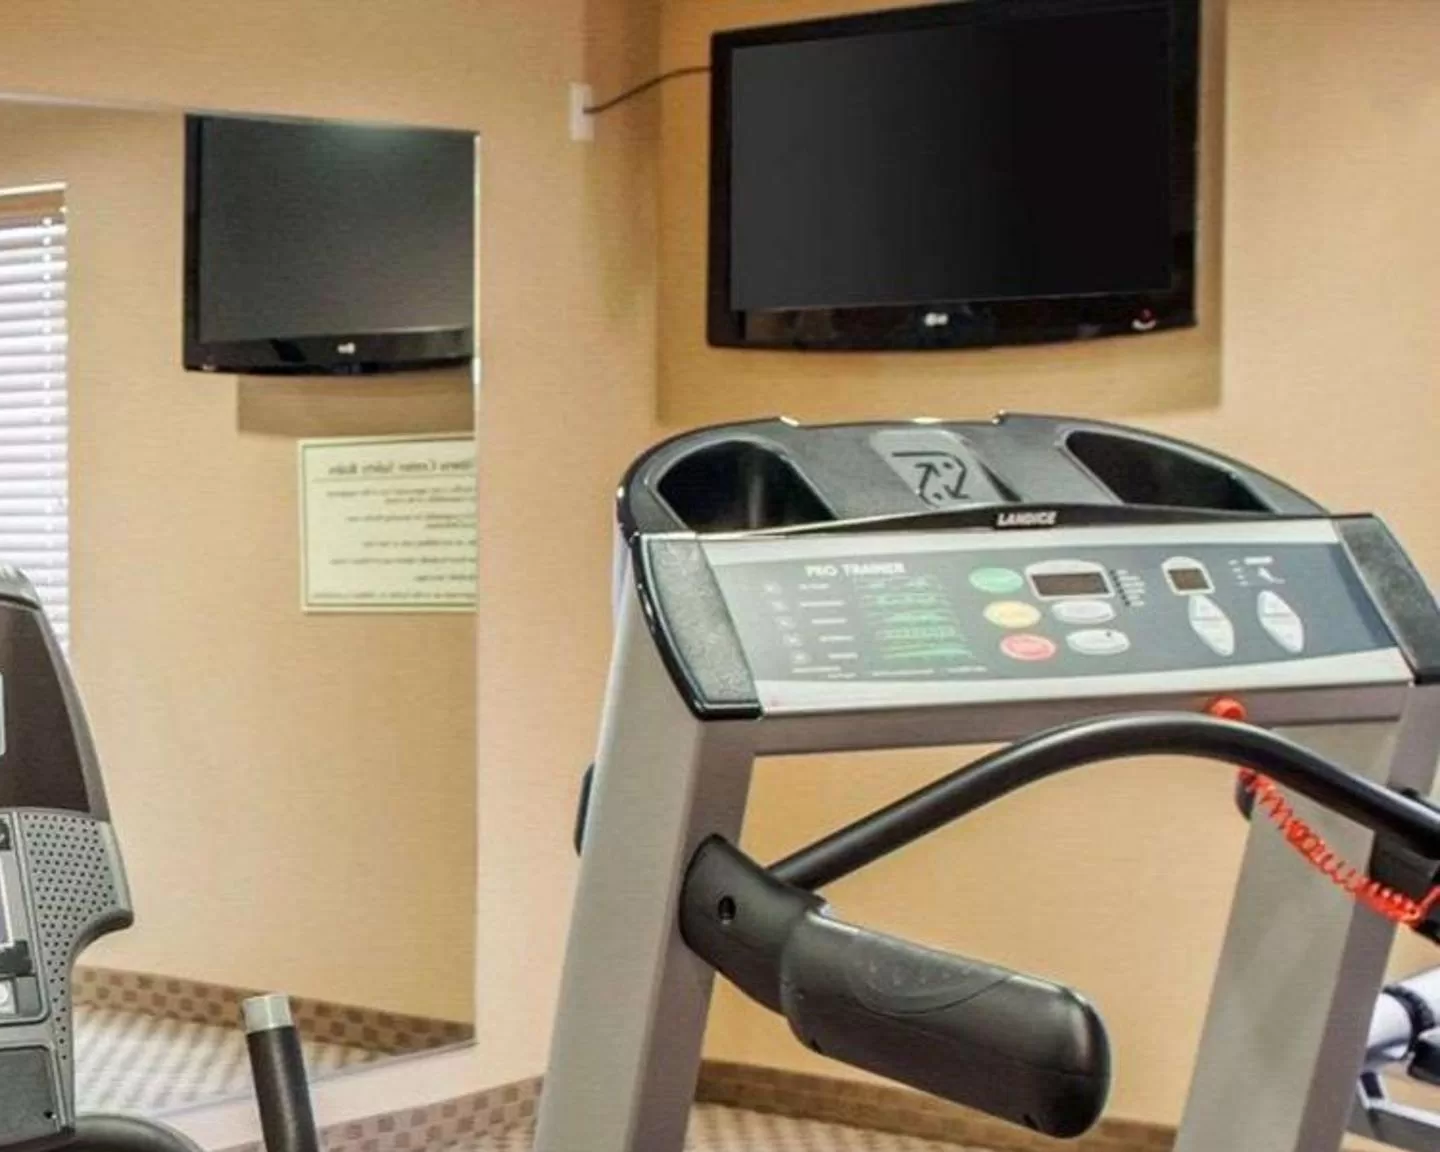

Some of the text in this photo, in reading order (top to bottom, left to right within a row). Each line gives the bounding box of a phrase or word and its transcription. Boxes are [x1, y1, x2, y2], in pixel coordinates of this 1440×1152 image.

[997, 510, 1057, 527] LANDICE
[804, 561, 905, 577] PRO TRAINER
